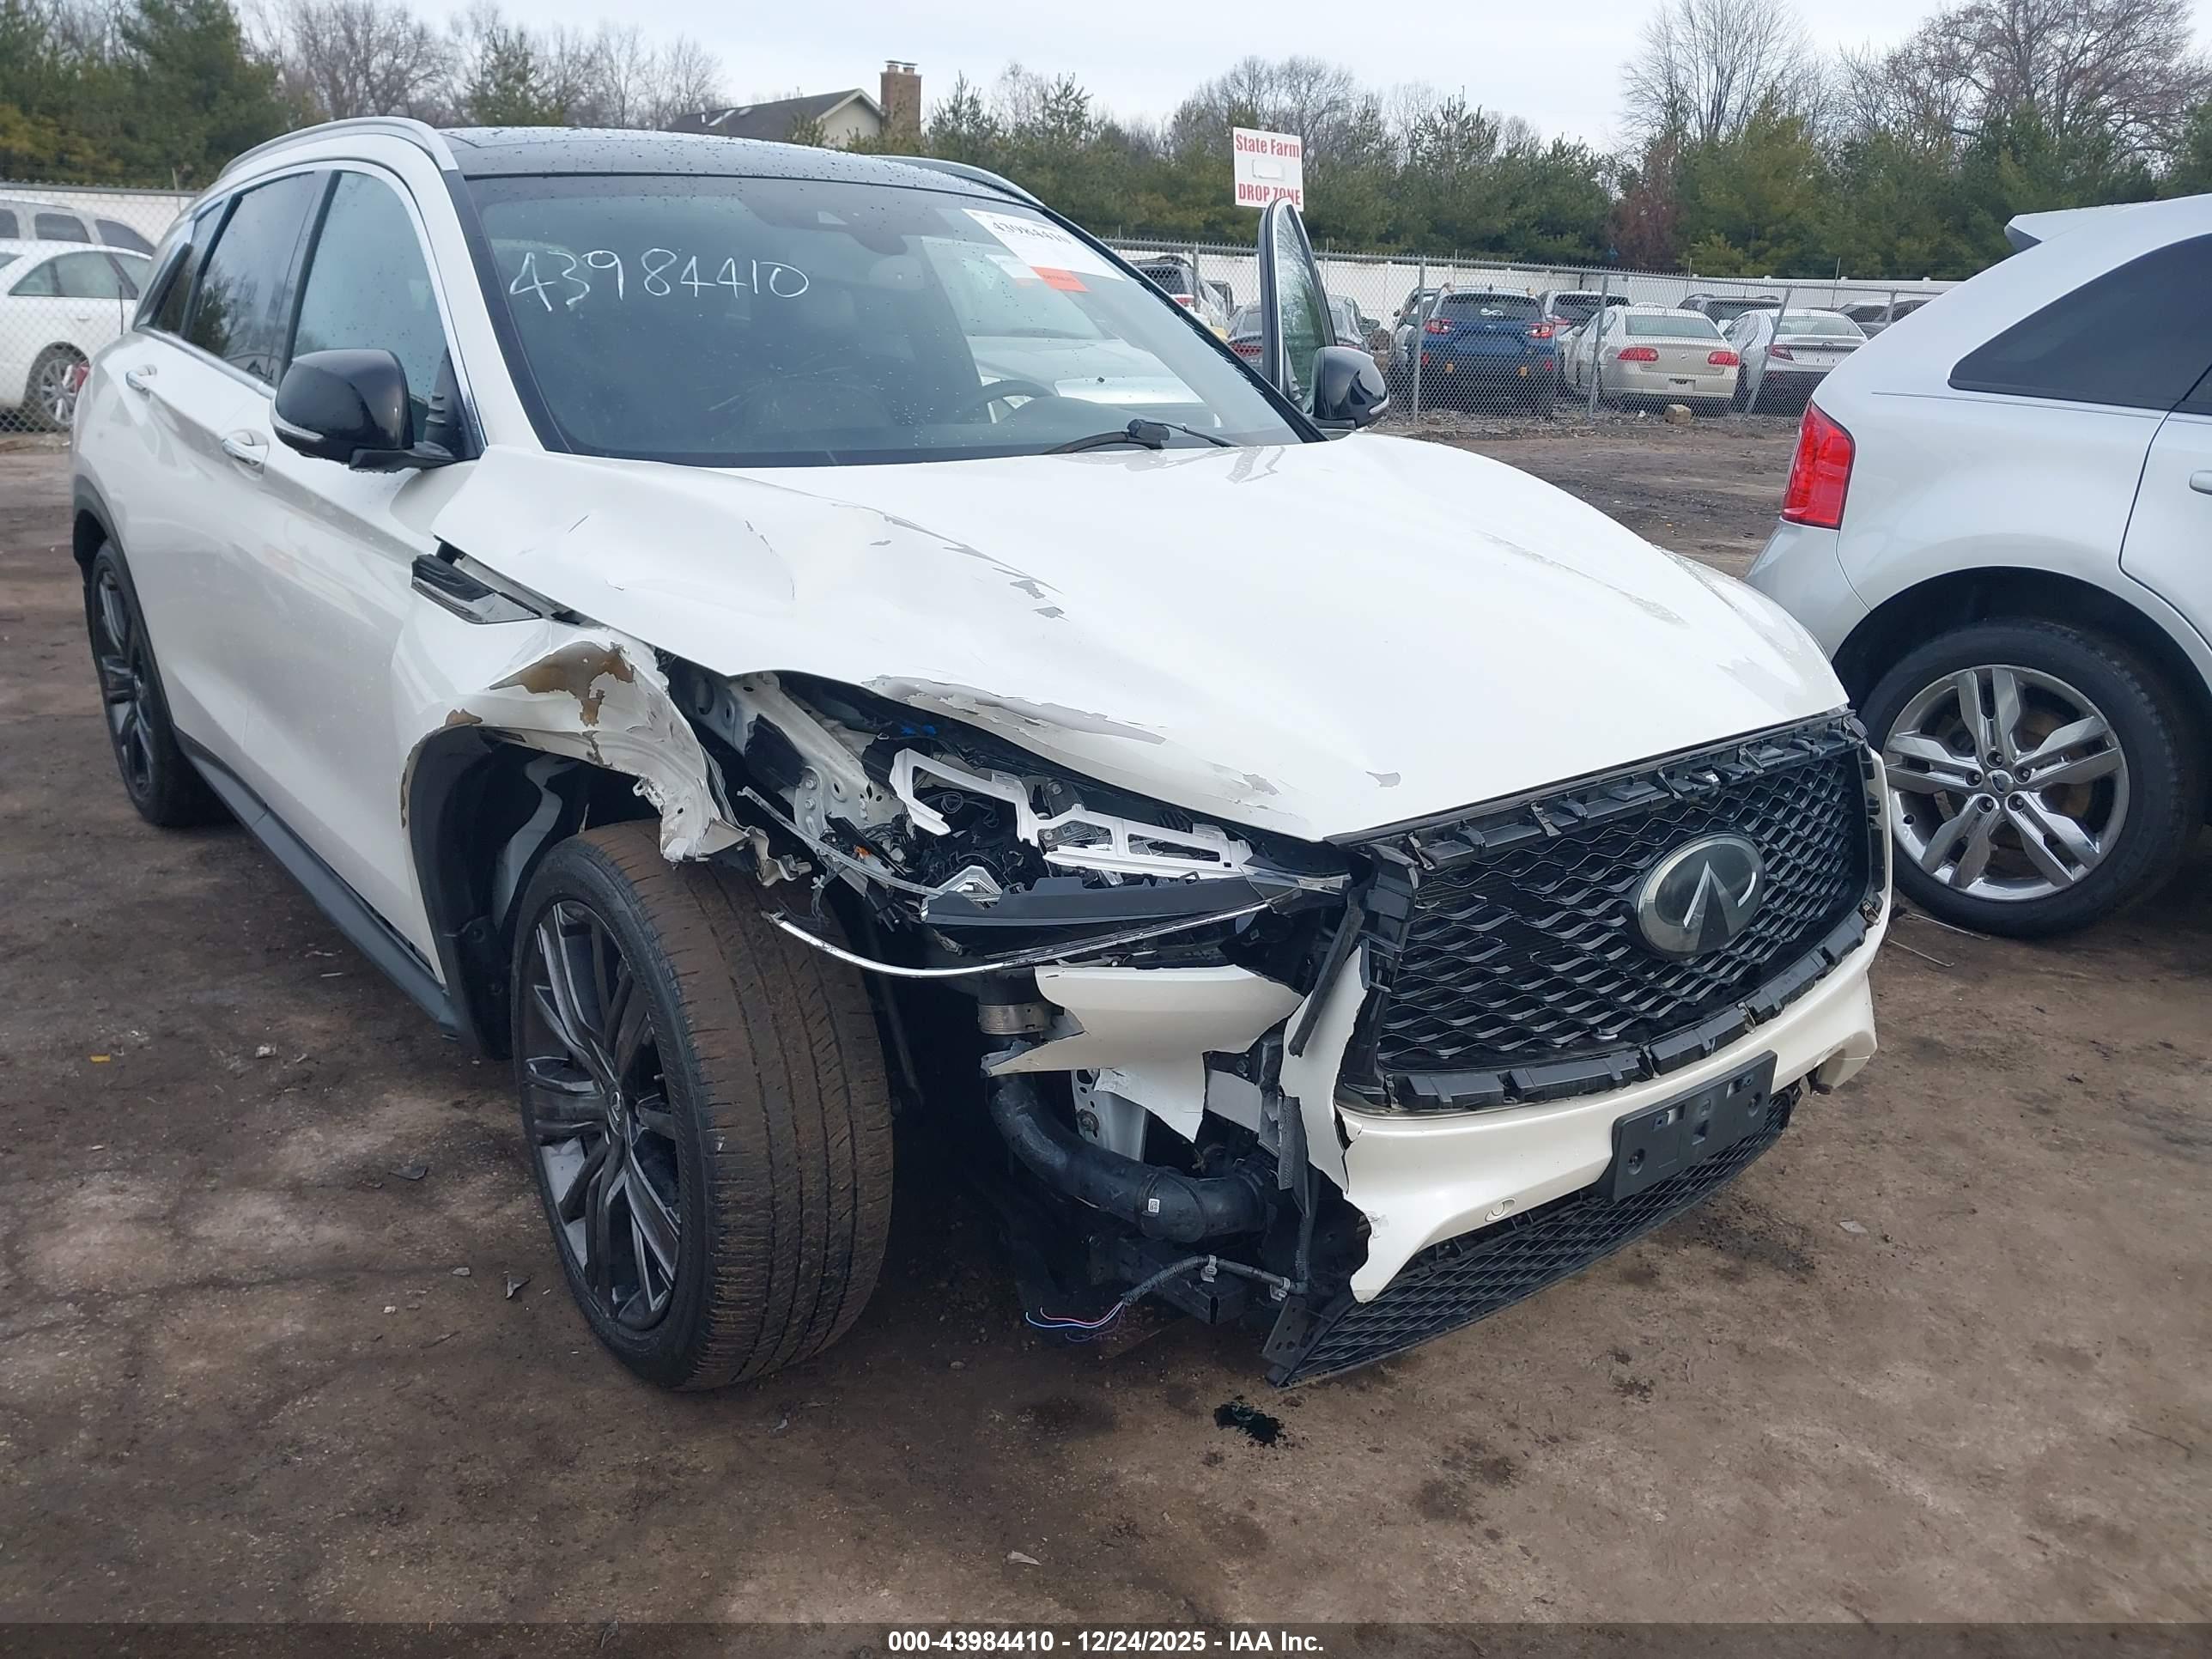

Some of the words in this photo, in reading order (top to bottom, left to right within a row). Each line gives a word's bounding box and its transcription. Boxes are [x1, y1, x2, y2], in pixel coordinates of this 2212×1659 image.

[1236, 134, 1267, 154] State
[1271, 139, 1299, 158] Farm
[1238, 183, 1270, 202] DROP
[510, 248, 809, 311] 43984410
